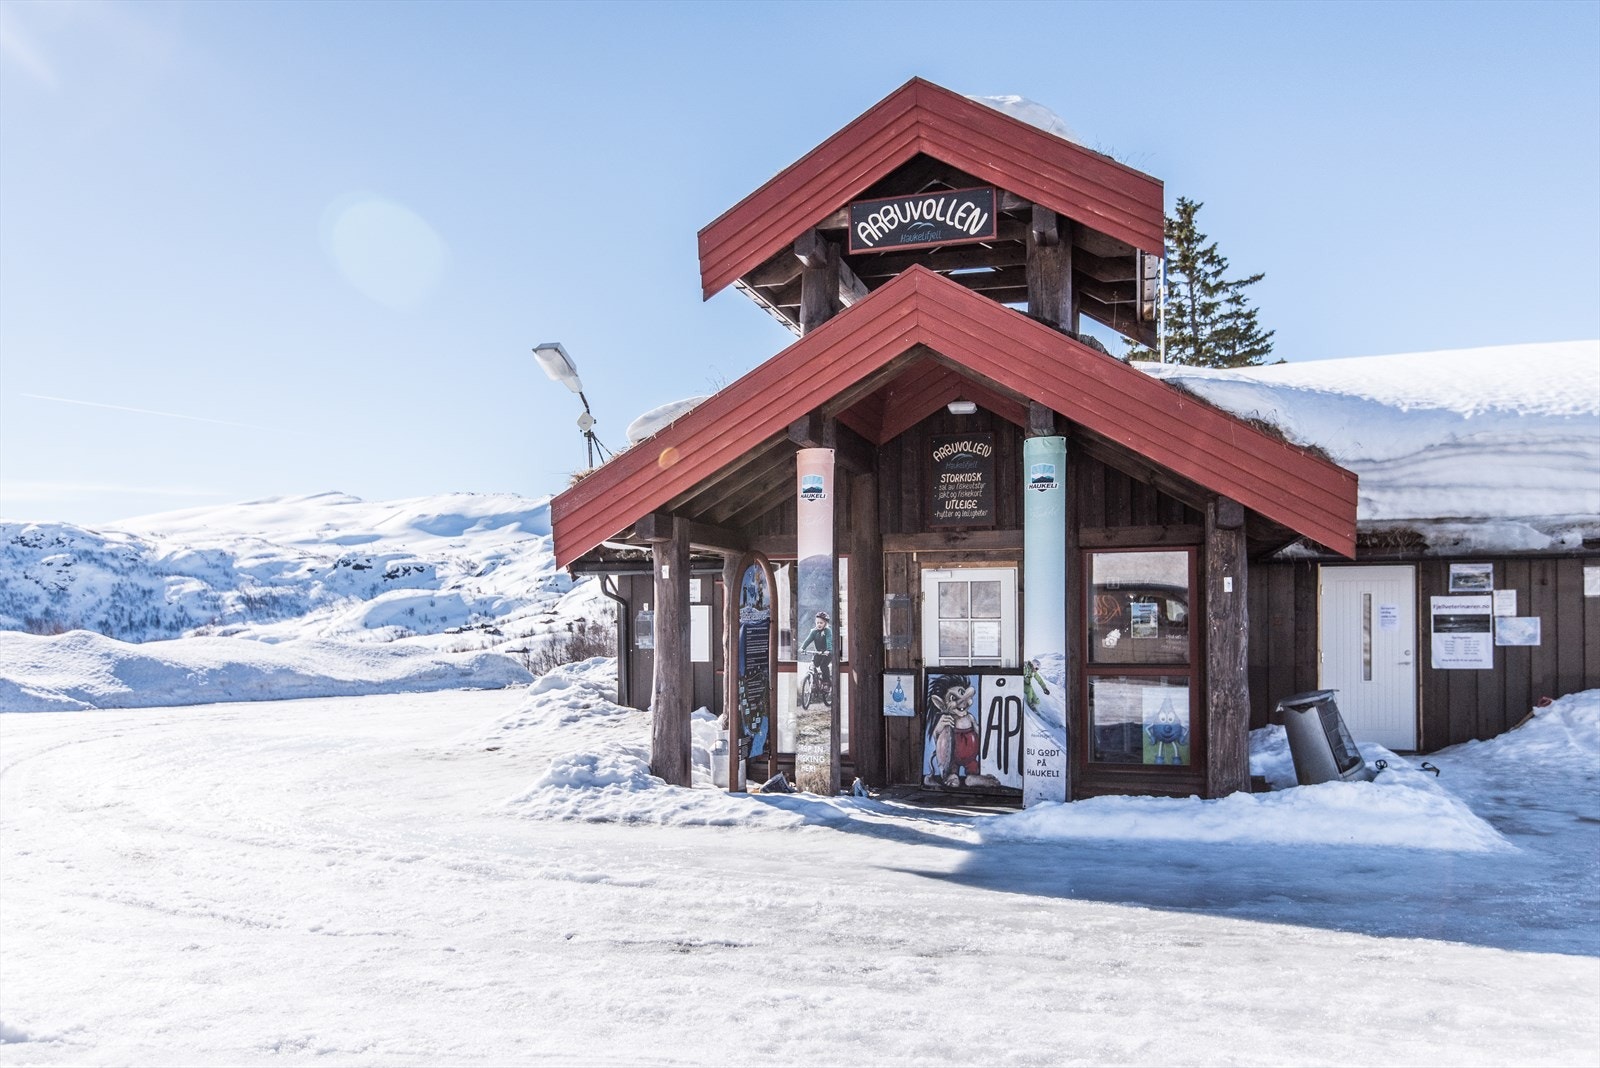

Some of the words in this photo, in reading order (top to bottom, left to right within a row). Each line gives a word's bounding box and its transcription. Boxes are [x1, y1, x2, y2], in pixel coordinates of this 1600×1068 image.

[857, 197, 989, 247] ARBUVOLLEN
[901, 230, 942, 243] Haukelifjell
[933, 441, 992, 462] ARBUVOLLEN
[940, 472, 982, 483] STORKIOSK
[945, 500, 978, 509] UTLEIGE
[1027, 748, 1035, 756] BU
[1038, 749, 1060, 757] GODT
[1037, 758, 1047, 767] PÅ
[1027, 770, 1060, 778] HAUKELI
